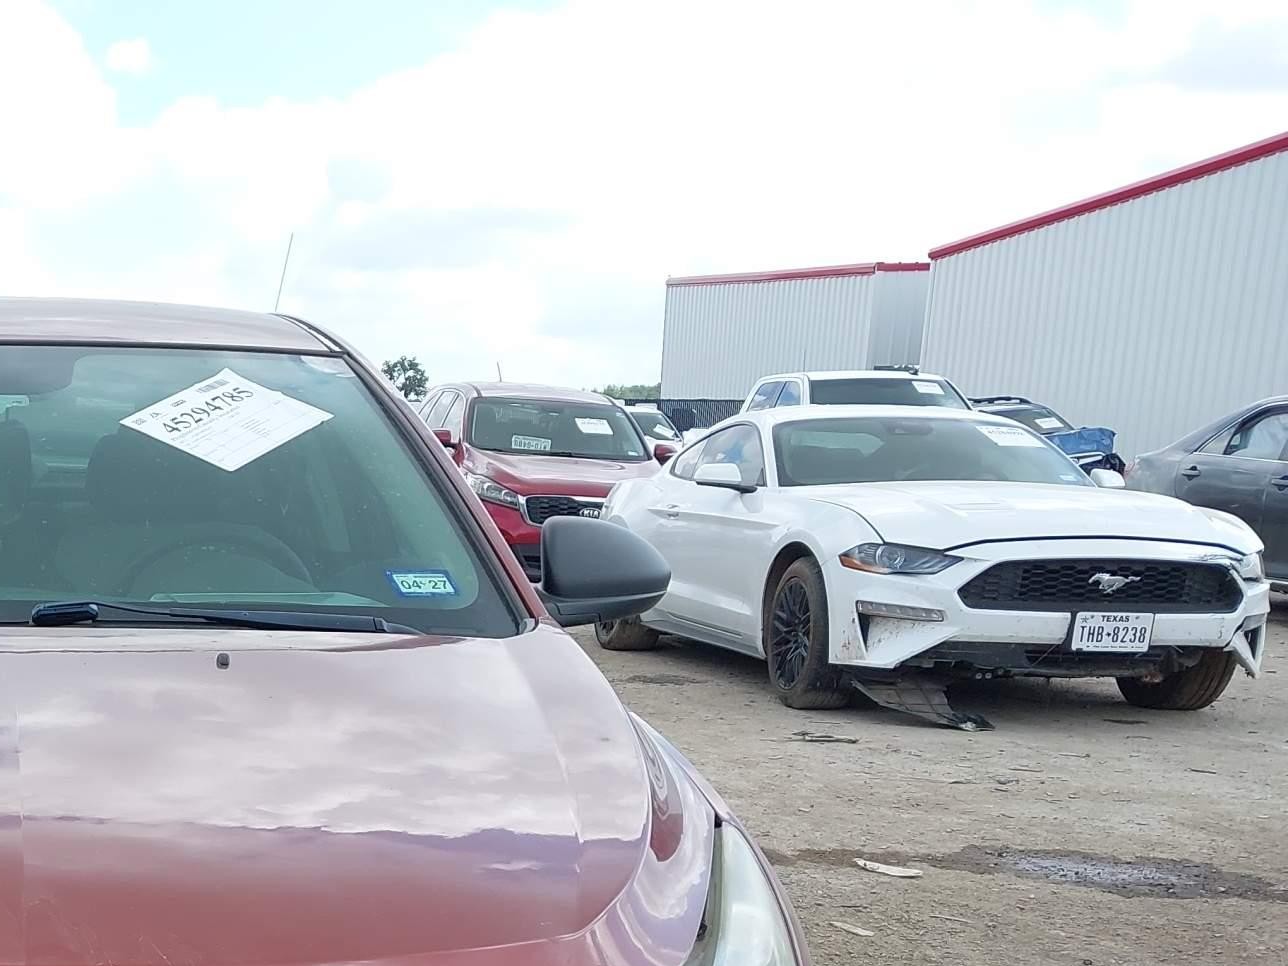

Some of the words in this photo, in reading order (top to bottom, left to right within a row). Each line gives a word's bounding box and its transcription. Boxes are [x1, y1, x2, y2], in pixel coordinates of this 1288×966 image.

[163, 387, 254, 434] 45294785
[583, 509, 599, 518] KIA
[400, 580, 422, 590] 04
[1101, 615, 1130, 623] TEXAS
